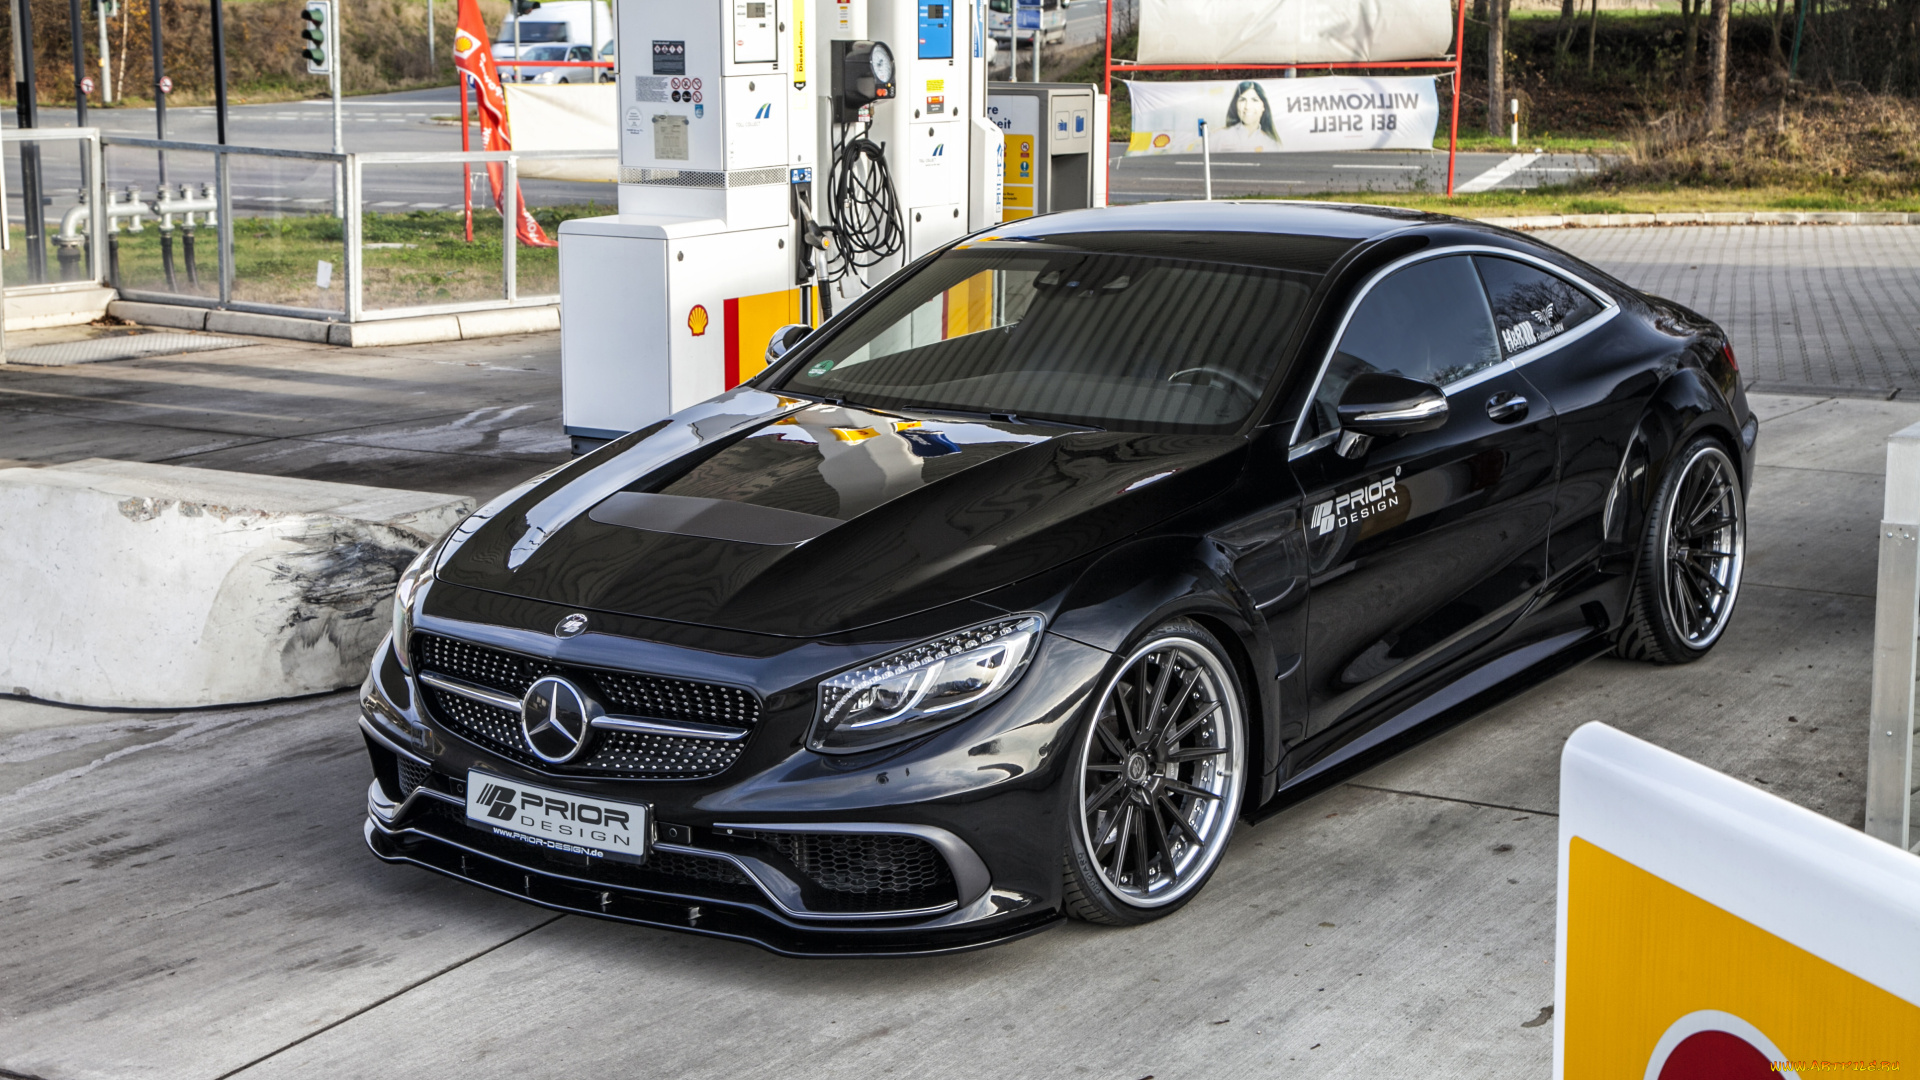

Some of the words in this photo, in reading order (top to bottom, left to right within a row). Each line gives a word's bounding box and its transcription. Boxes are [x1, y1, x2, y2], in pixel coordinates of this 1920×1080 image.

[1336, 476, 1397, 515] PRIOR
[1338, 496, 1399, 528] DESIGN
[520, 791, 630, 831] PRIOR
[492, 827, 604, 858] www.PRIOR-DESIGN.de
[520, 815, 630, 846] DESIGN
